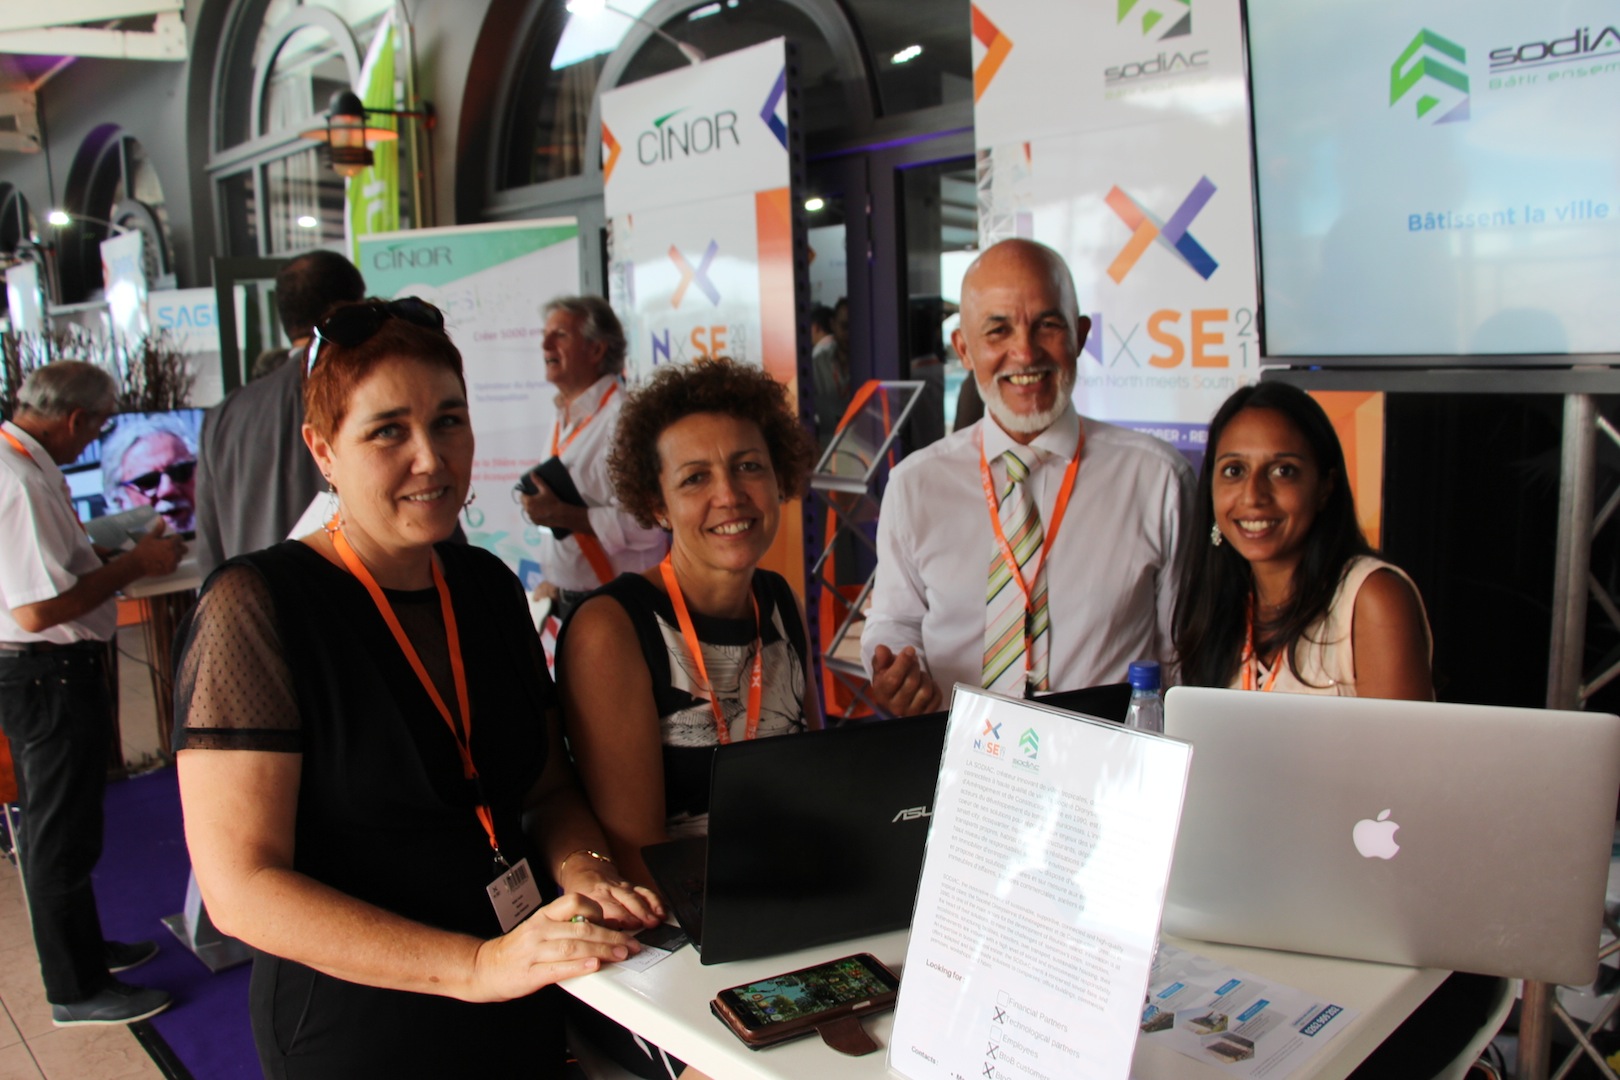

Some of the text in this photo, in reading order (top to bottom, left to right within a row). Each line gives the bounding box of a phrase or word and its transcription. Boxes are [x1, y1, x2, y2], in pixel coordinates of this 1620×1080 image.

[1547, 62, 1620, 82] ensem
[638, 109, 740, 166] CINOR
[1408, 200, 1610, 233] Bâtissent la ville
[373, 246, 453, 271] CINOR
[1106, 375, 1143, 388] North
[1146, 375, 1190, 388] meets
[891, 805, 934, 824] ASU
[925, 957, 952, 978] Looking
[1008, 996, 1068, 1033] Financial Partners
[1001, 1032, 1039, 1060] Employees
[1005, 1014, 1081, 1061] Technological partners
